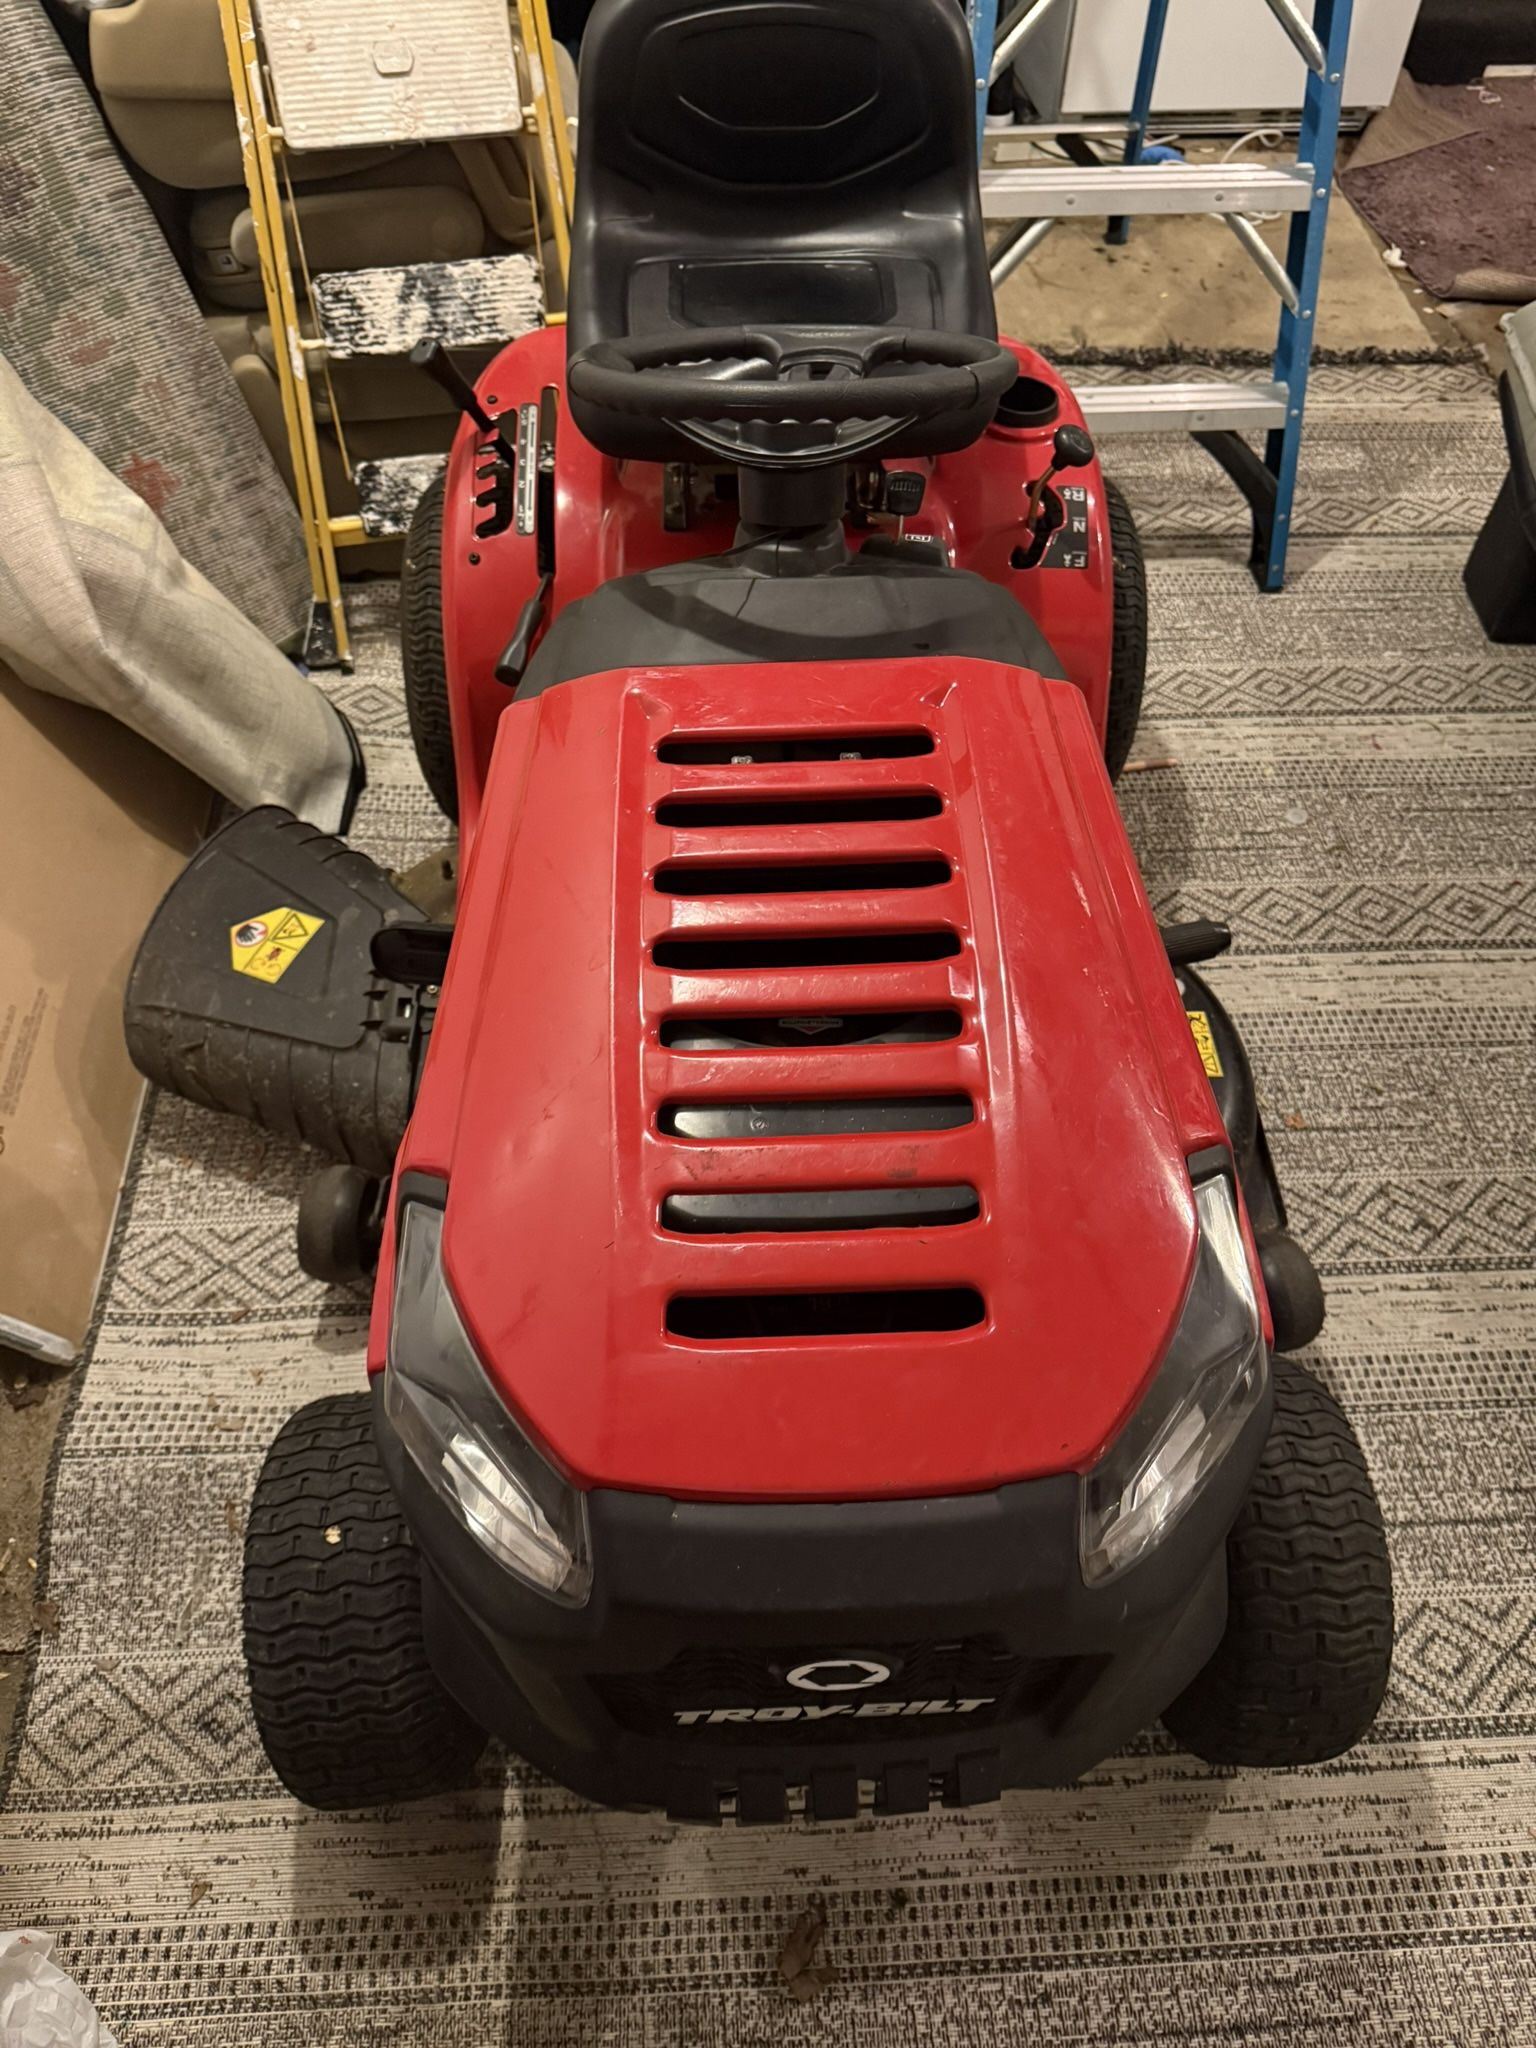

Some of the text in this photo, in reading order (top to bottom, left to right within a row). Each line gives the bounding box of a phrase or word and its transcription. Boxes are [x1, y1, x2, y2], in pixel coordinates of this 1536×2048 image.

[1072, 490, 1085, 502] R
[1072, 521, 1086, 533] N
[1073, 555, 1086, 567] F
[673, 1698, 996, 1725] TROY-BILT
